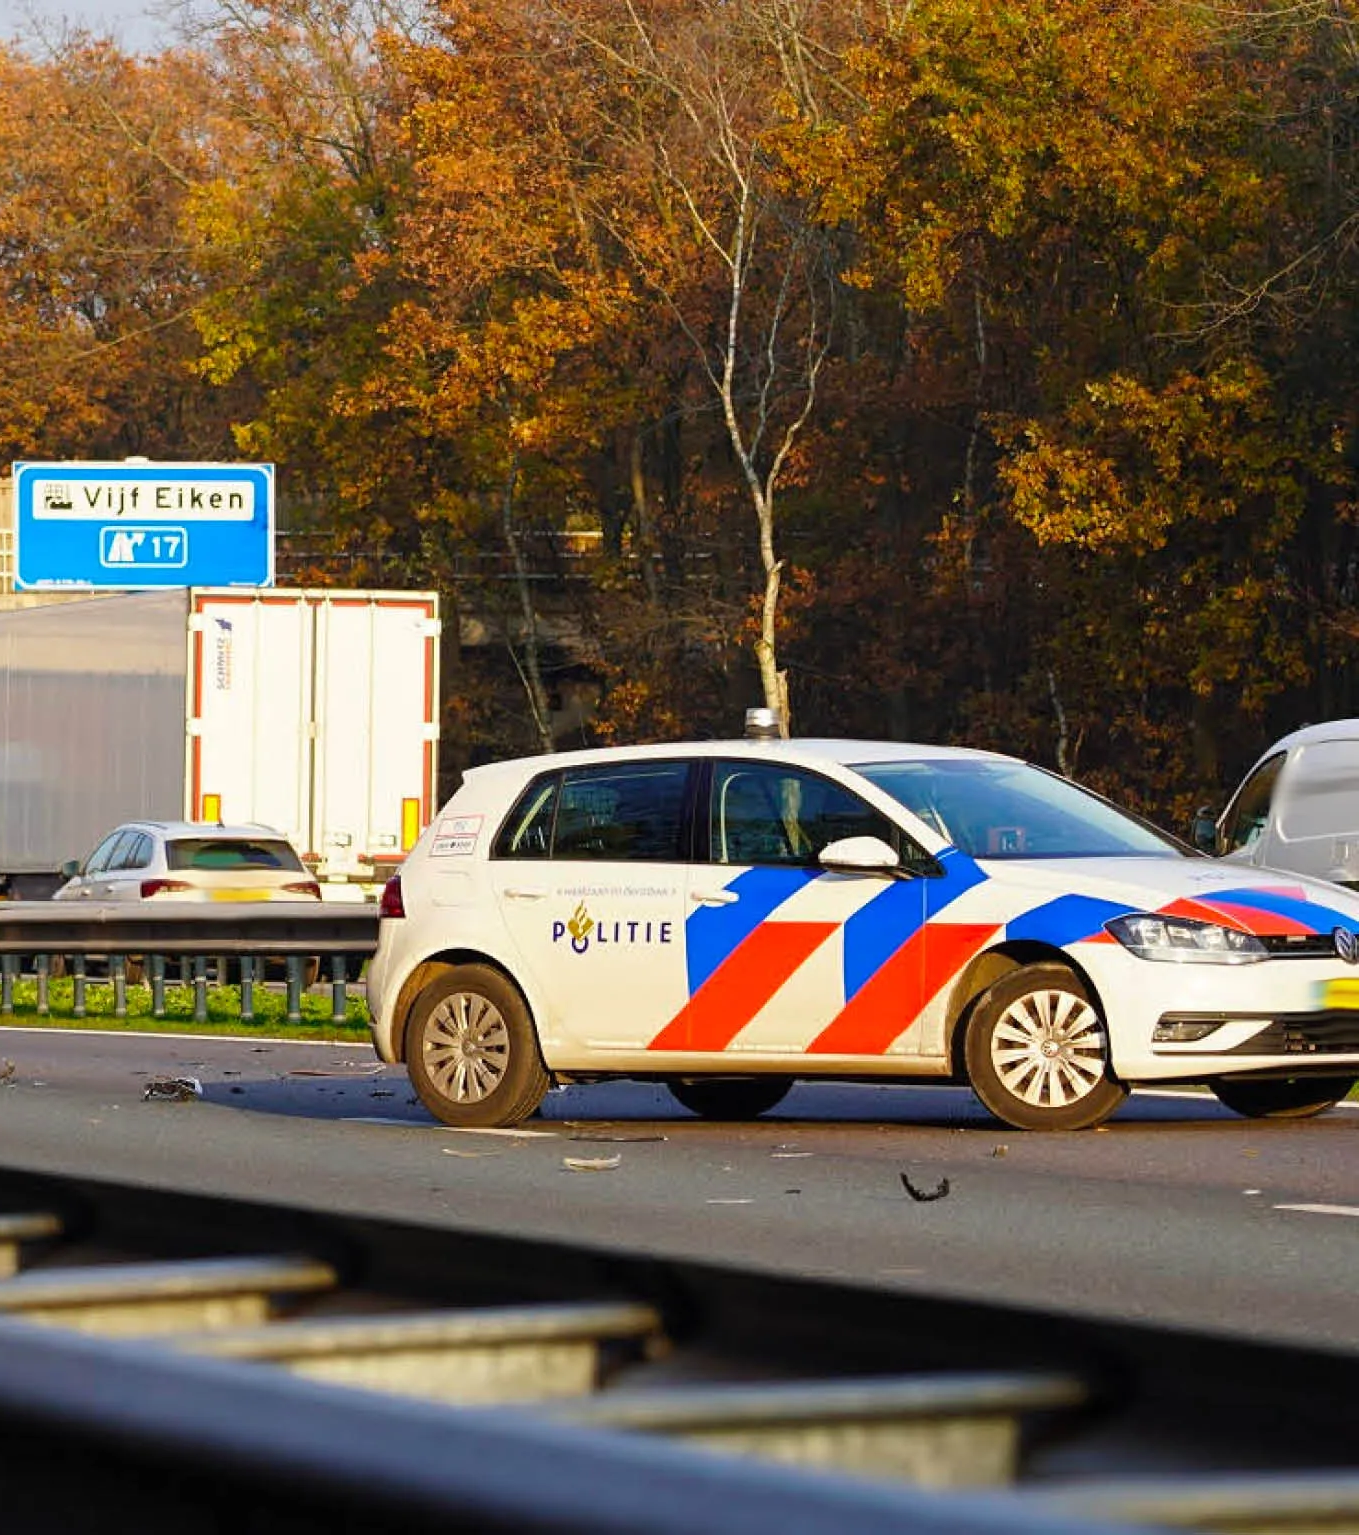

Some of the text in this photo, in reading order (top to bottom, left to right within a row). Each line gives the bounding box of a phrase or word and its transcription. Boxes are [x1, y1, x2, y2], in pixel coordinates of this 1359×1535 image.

[83, 486, 244, 516] Vijf Eiken
[152, 536, 181, 559] 17
[552, 920, 673, 954] POLITIE
